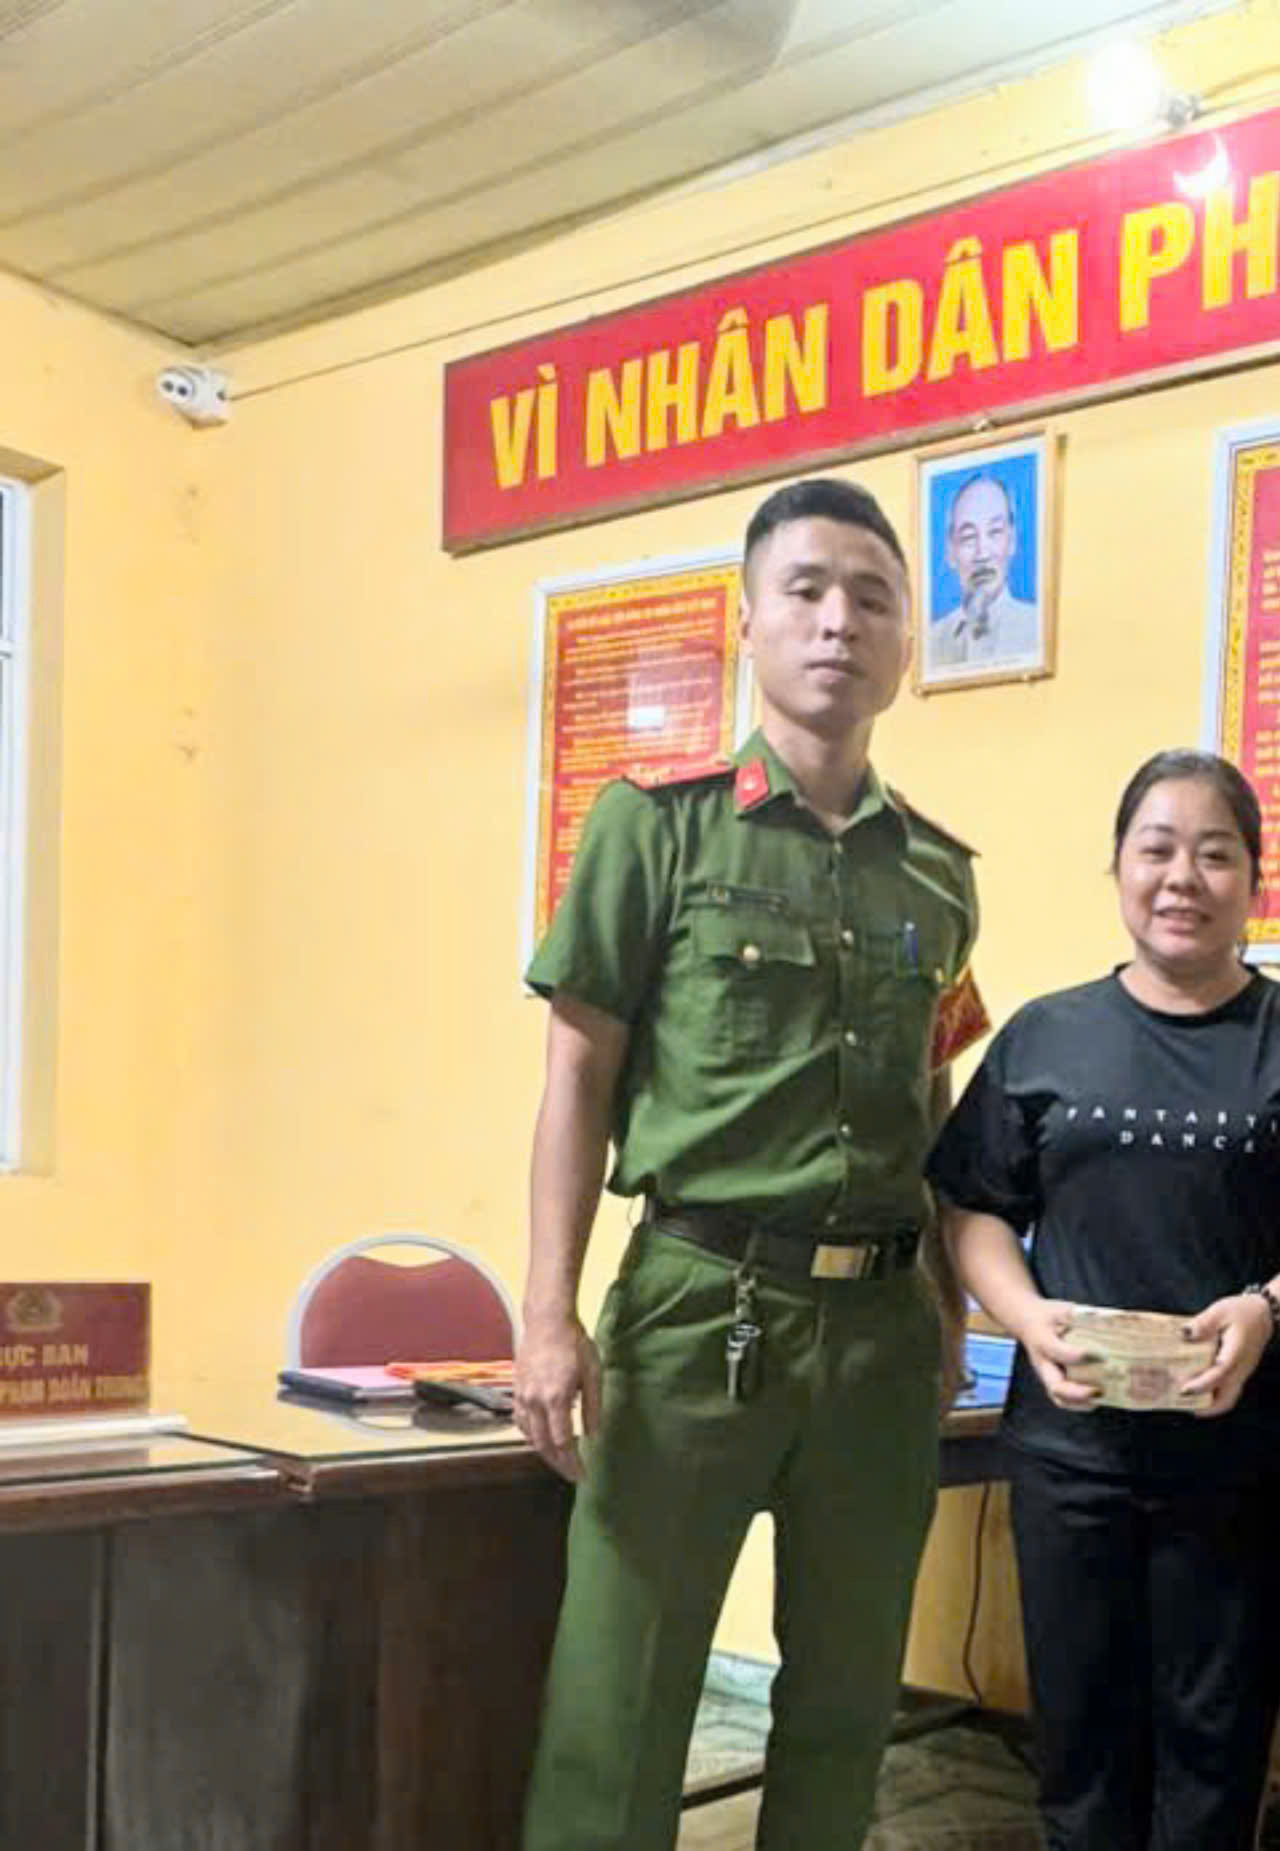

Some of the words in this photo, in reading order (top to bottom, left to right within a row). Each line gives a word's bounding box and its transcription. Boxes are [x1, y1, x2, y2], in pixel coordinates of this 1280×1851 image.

[490, 364, 558, 490] VÌ
[585, 304, 828, 467] NHÂN
[861, 234, 1079, 398] DÂN
